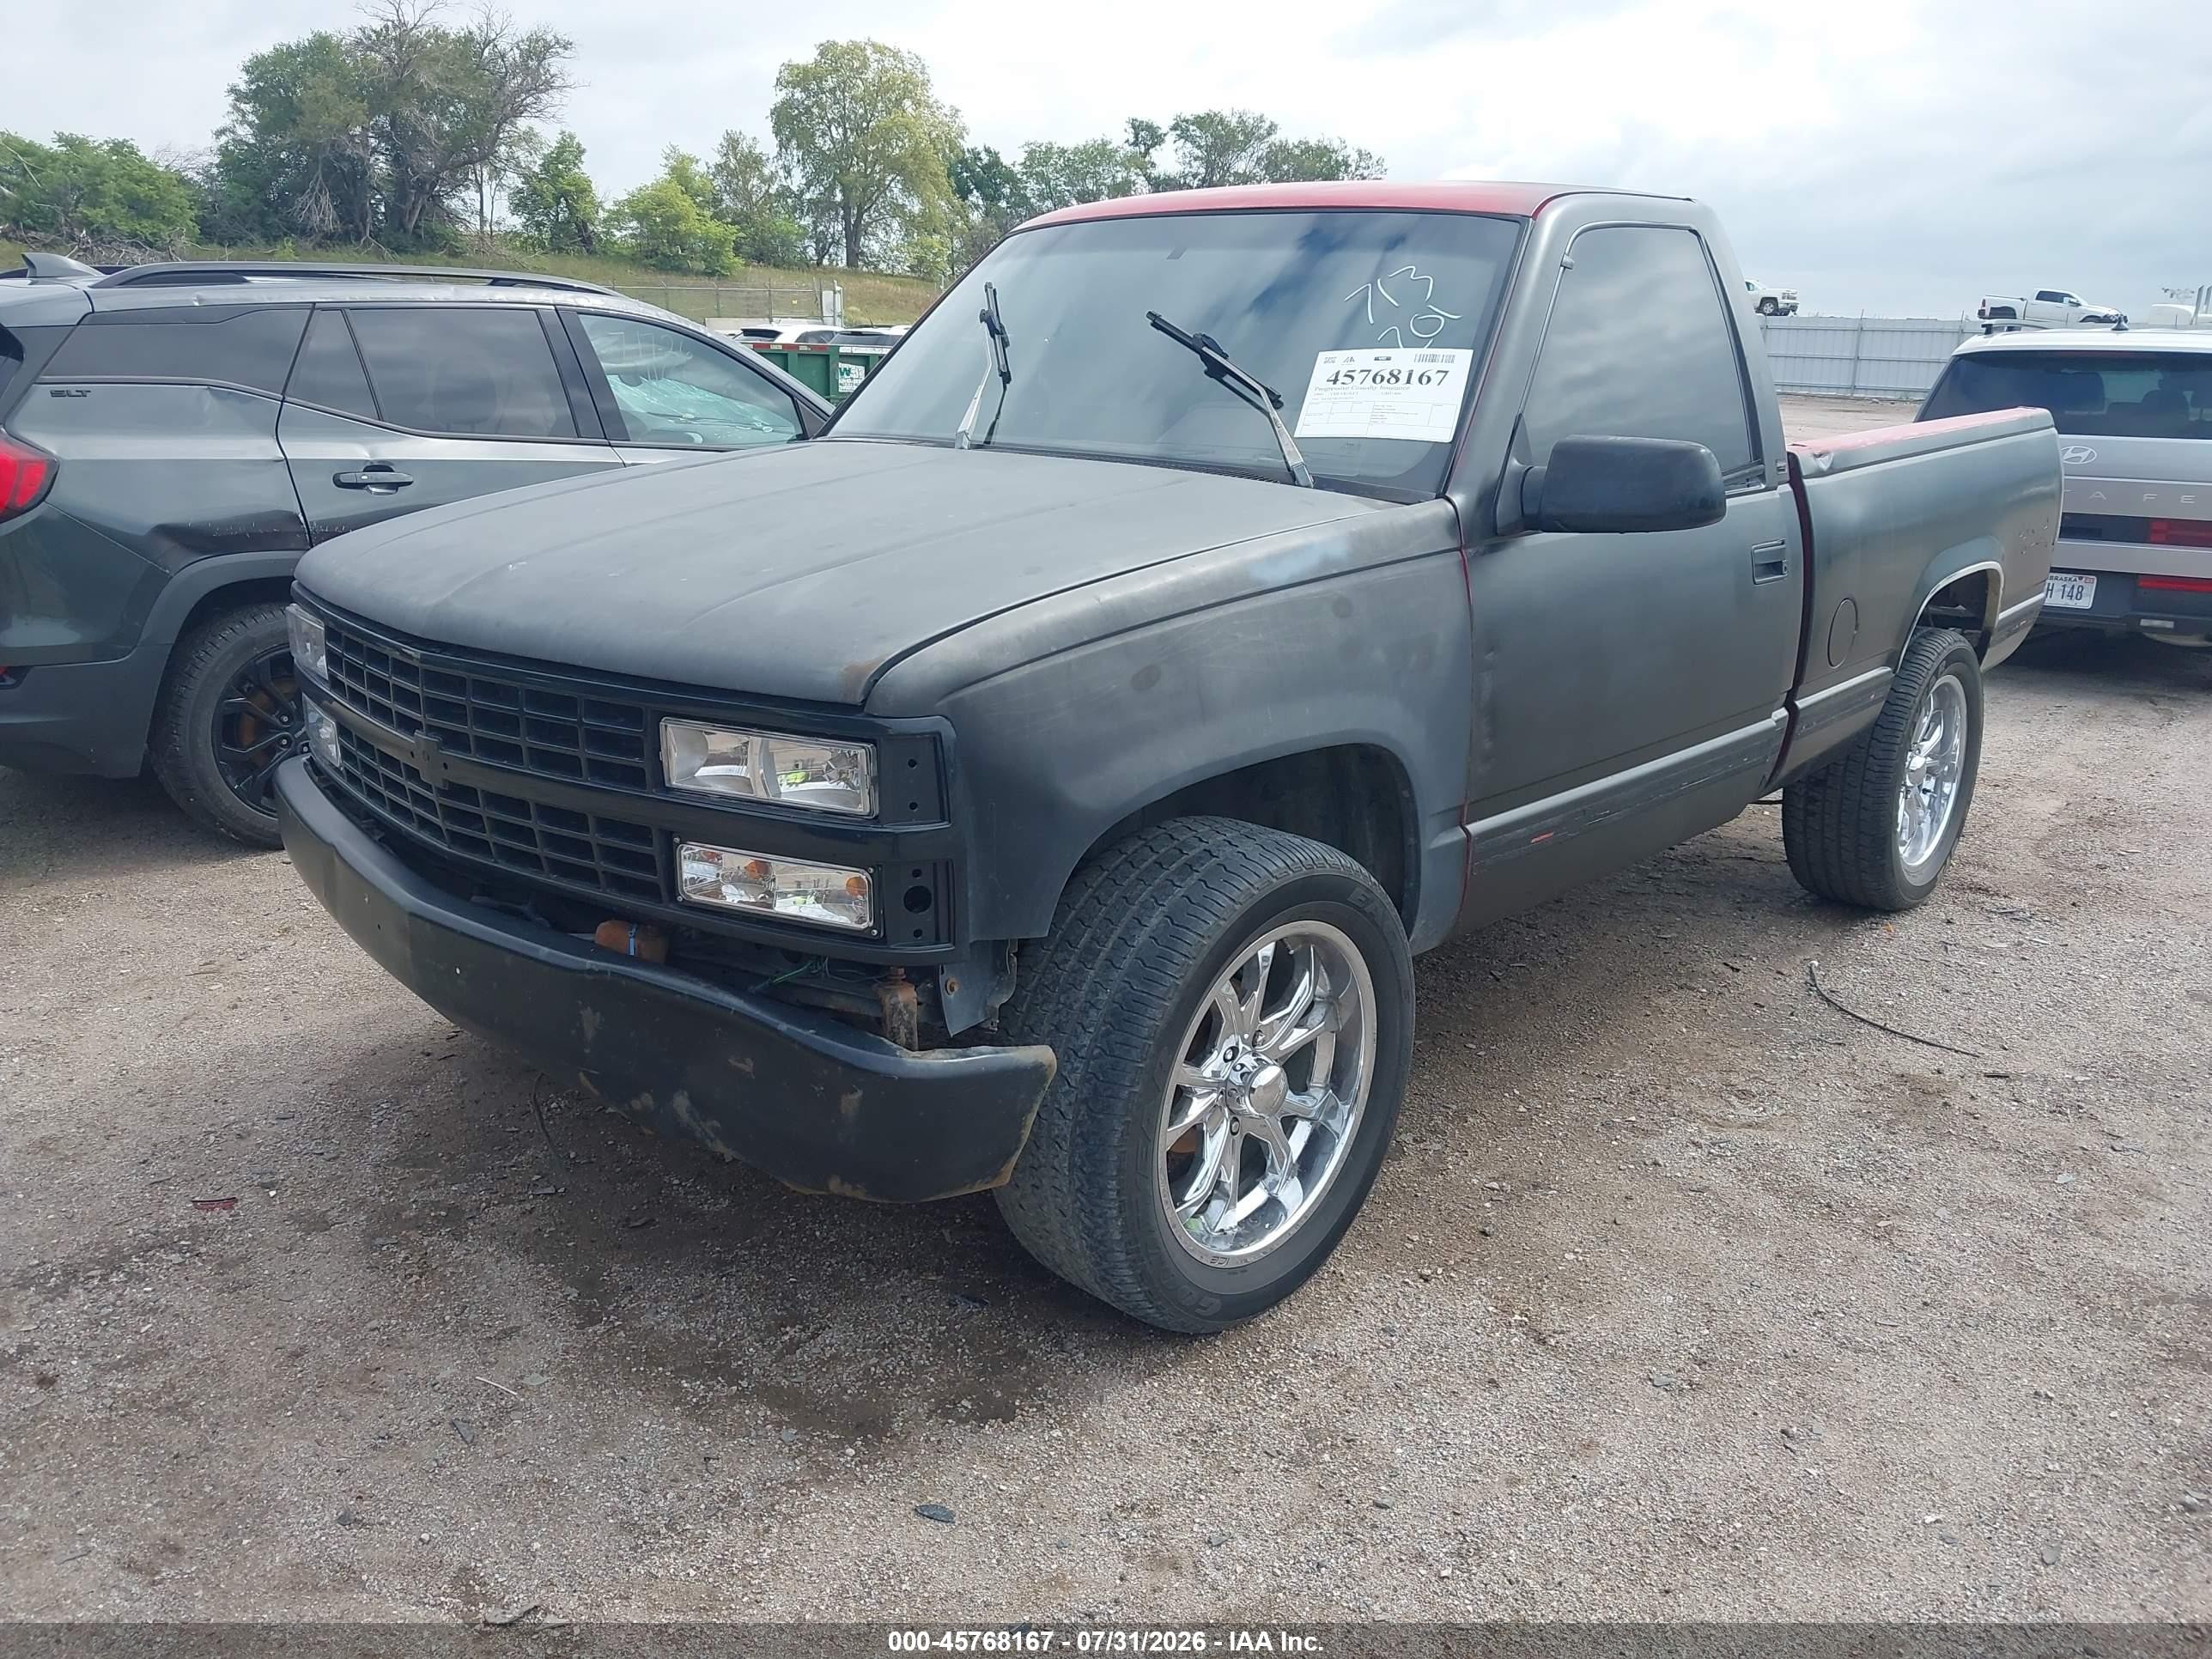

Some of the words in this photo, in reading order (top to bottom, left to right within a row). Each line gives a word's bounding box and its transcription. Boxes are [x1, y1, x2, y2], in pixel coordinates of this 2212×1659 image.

[1326, 368, 1449, 386] 45768167
[50, 389, 92, 398] SLT
[2142, 492, 2197, 505] FE
[2061, 584, 2084, 601] 148
